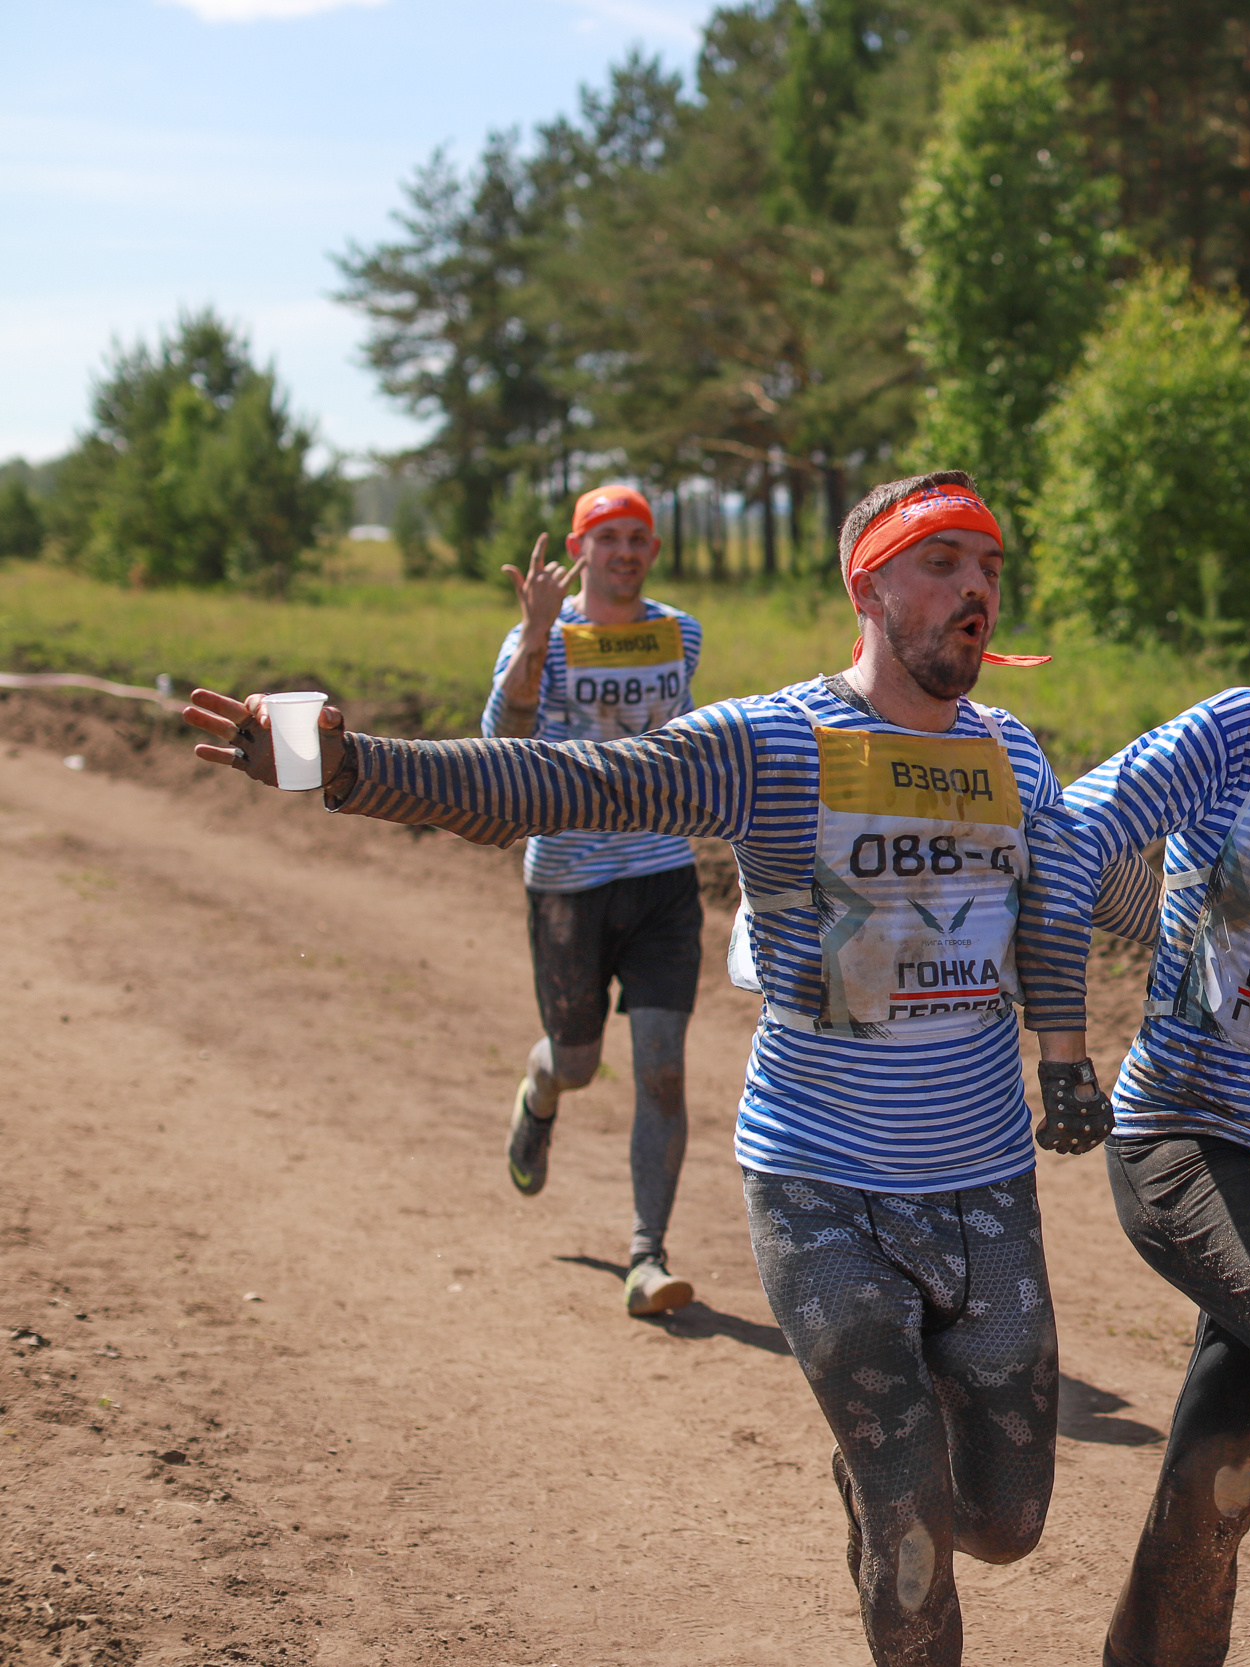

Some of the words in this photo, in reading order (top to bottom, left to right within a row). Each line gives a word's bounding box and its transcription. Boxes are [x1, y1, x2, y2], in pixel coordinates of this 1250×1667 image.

[599, 634, 660, 653] ВЗВОД
[575, 672, 680, 704] 088-10
[891, 761, 993, 801] ВЗВОД
[921, 939, 943, 947] ЛИГА
[945, 938, 972, 946] ГЕРОЕВ
[898, 958, 999, 989] ГОНКА
